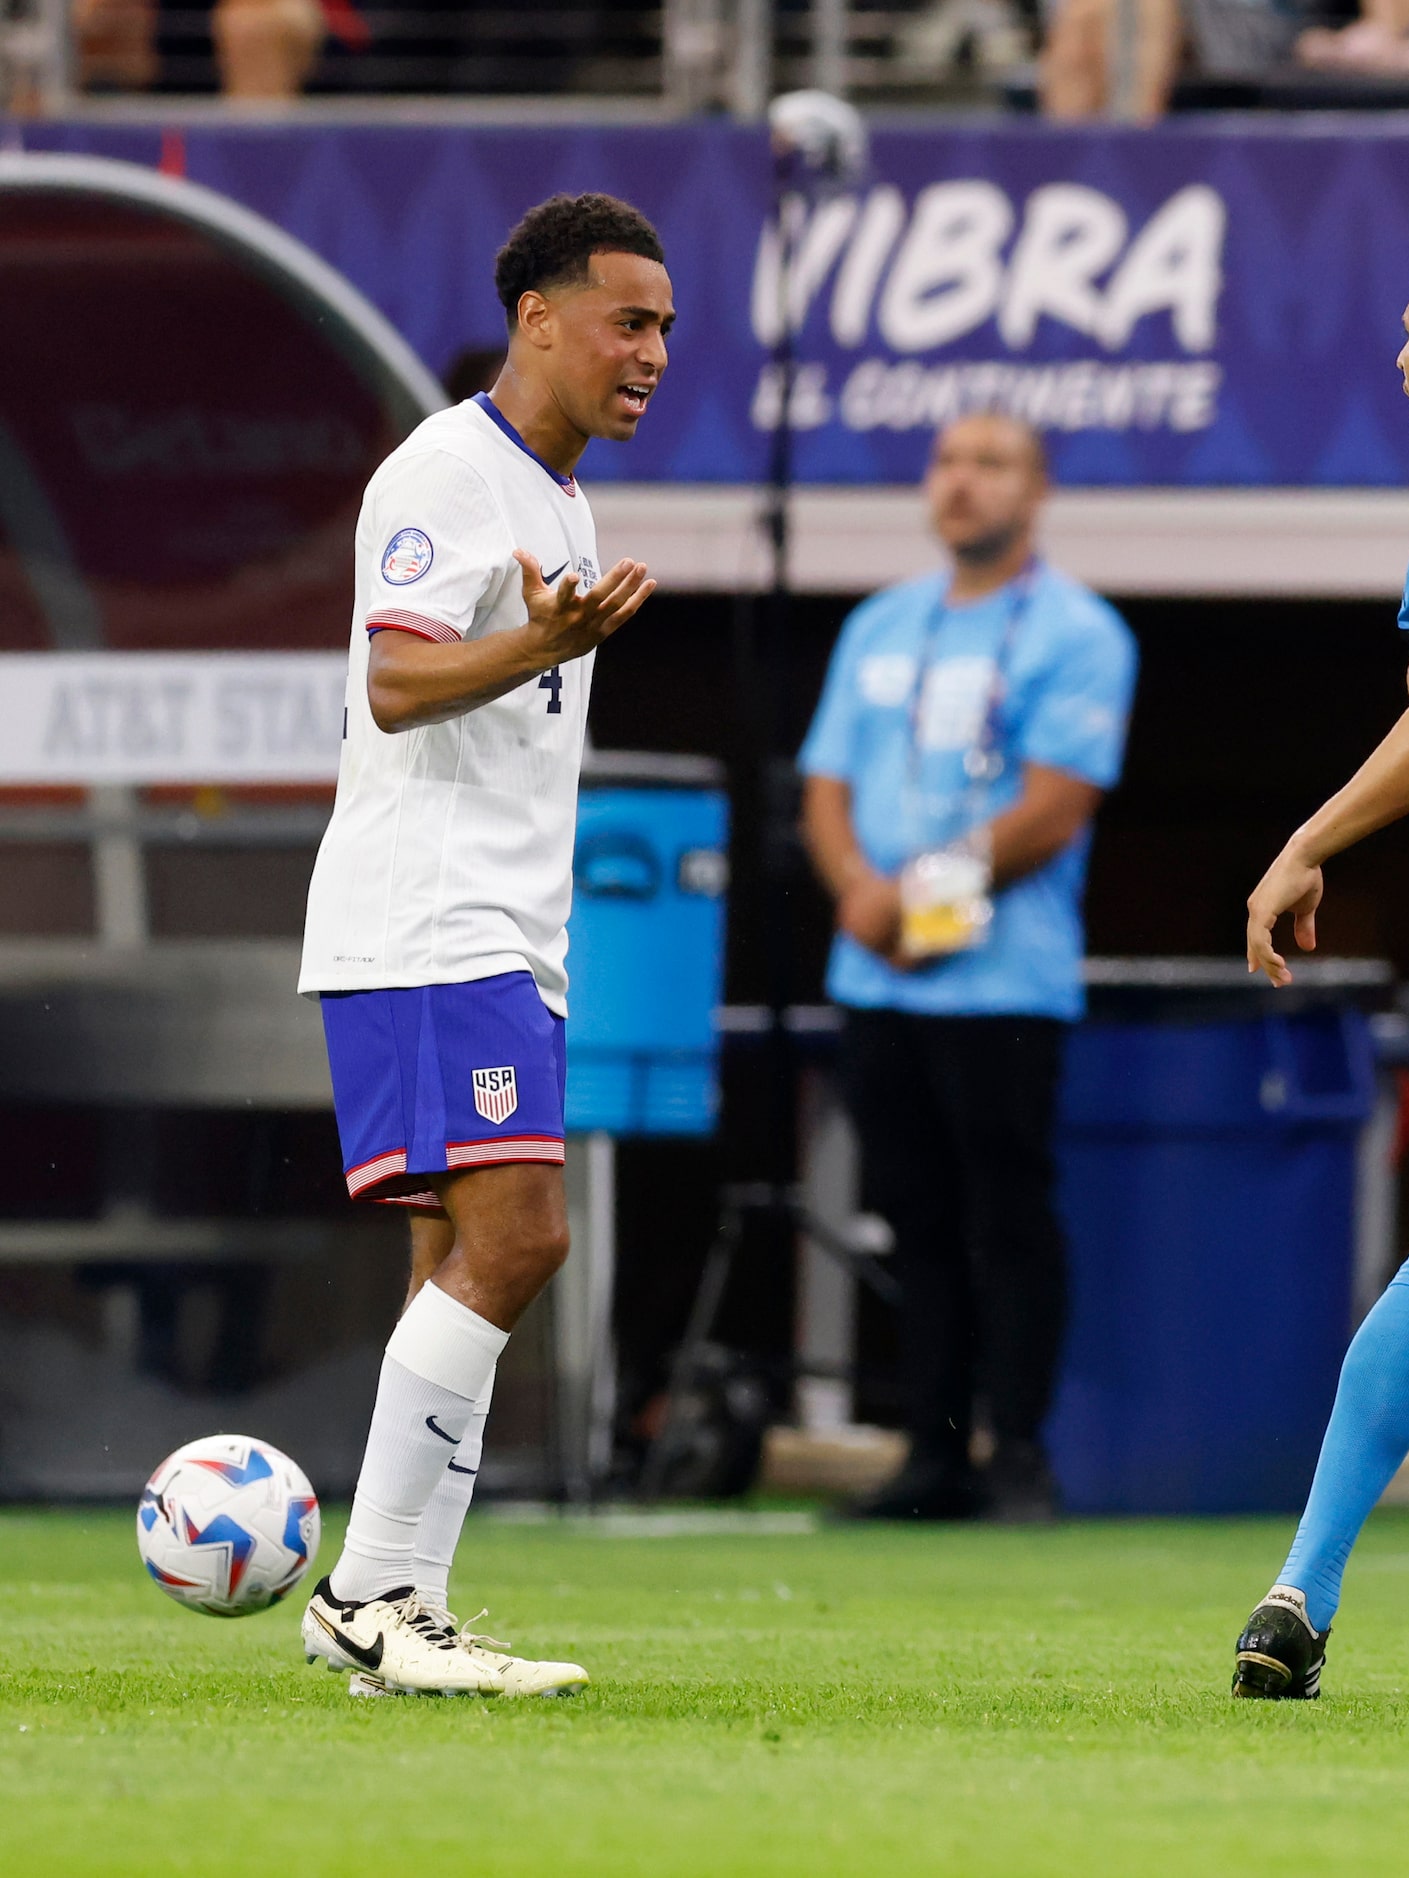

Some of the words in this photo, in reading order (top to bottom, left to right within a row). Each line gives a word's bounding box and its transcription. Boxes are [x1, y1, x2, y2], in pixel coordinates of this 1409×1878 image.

[751, 177, 1226, 353] VIBRA
[475, 1069, 512, 1091] USA
[1268, 1593, 1303, 1609] adidas
